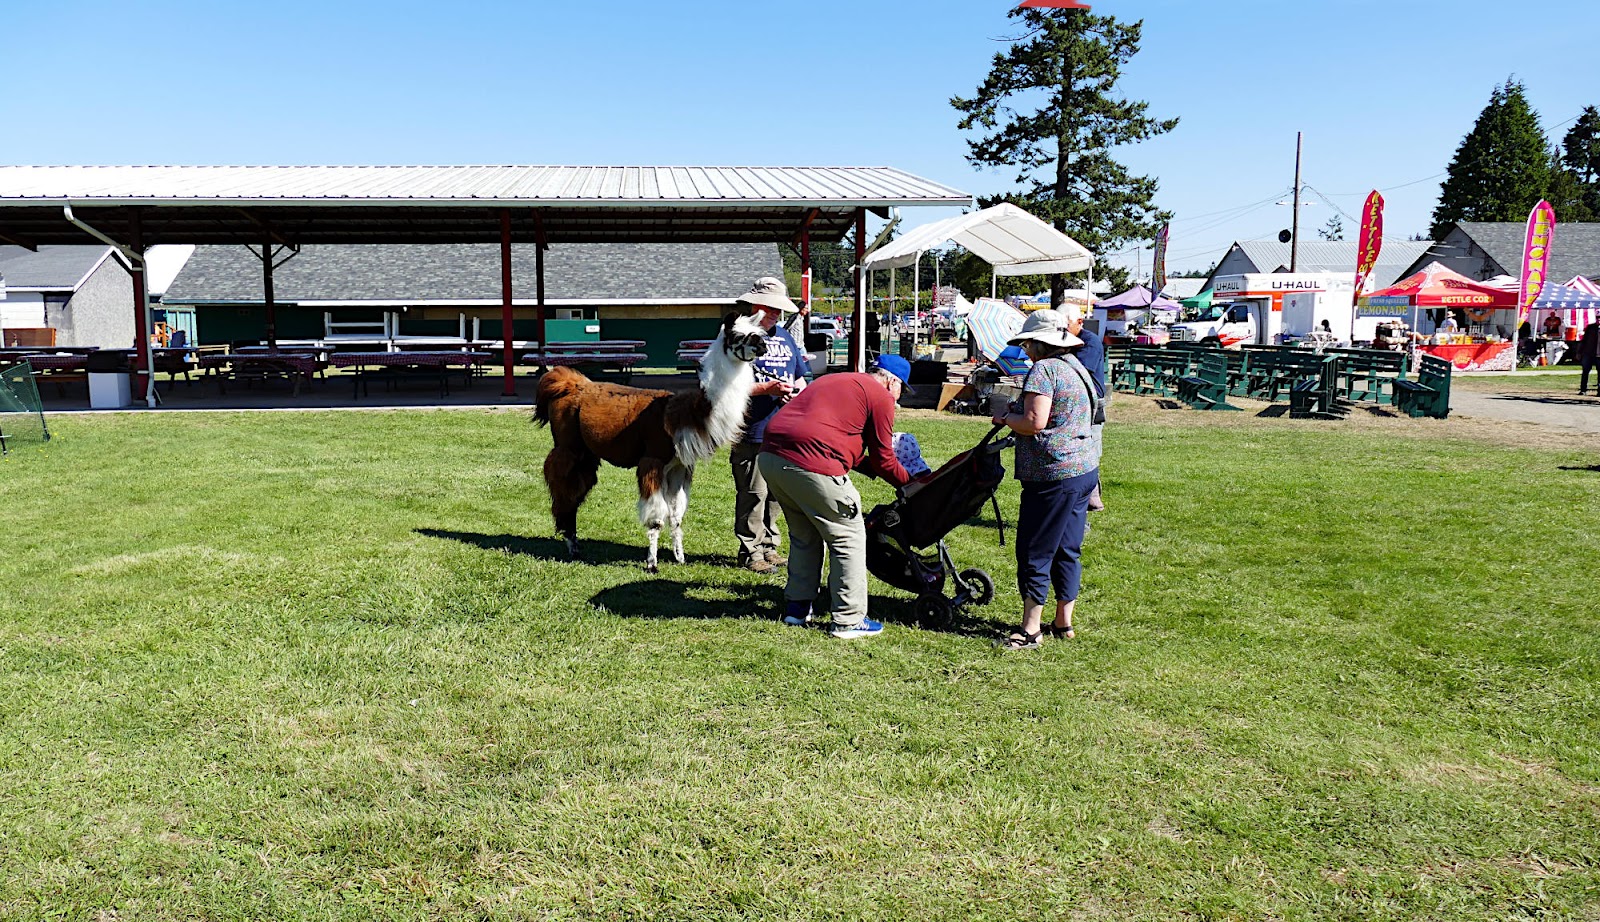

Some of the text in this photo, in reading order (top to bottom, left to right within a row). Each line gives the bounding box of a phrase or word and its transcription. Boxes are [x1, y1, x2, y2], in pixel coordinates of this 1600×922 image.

[1365, 191, 1379, 263] KETTLE
[1216, 282, 1240, 291] U-HAUL
[1272, 281, 1321, 289] U-HAUL
[1441, 295, 1494, 304] KETTLE CORN
[1358, 305, 1408, 316] LEMONADE
[763, 344, 793, 357] AMAS
